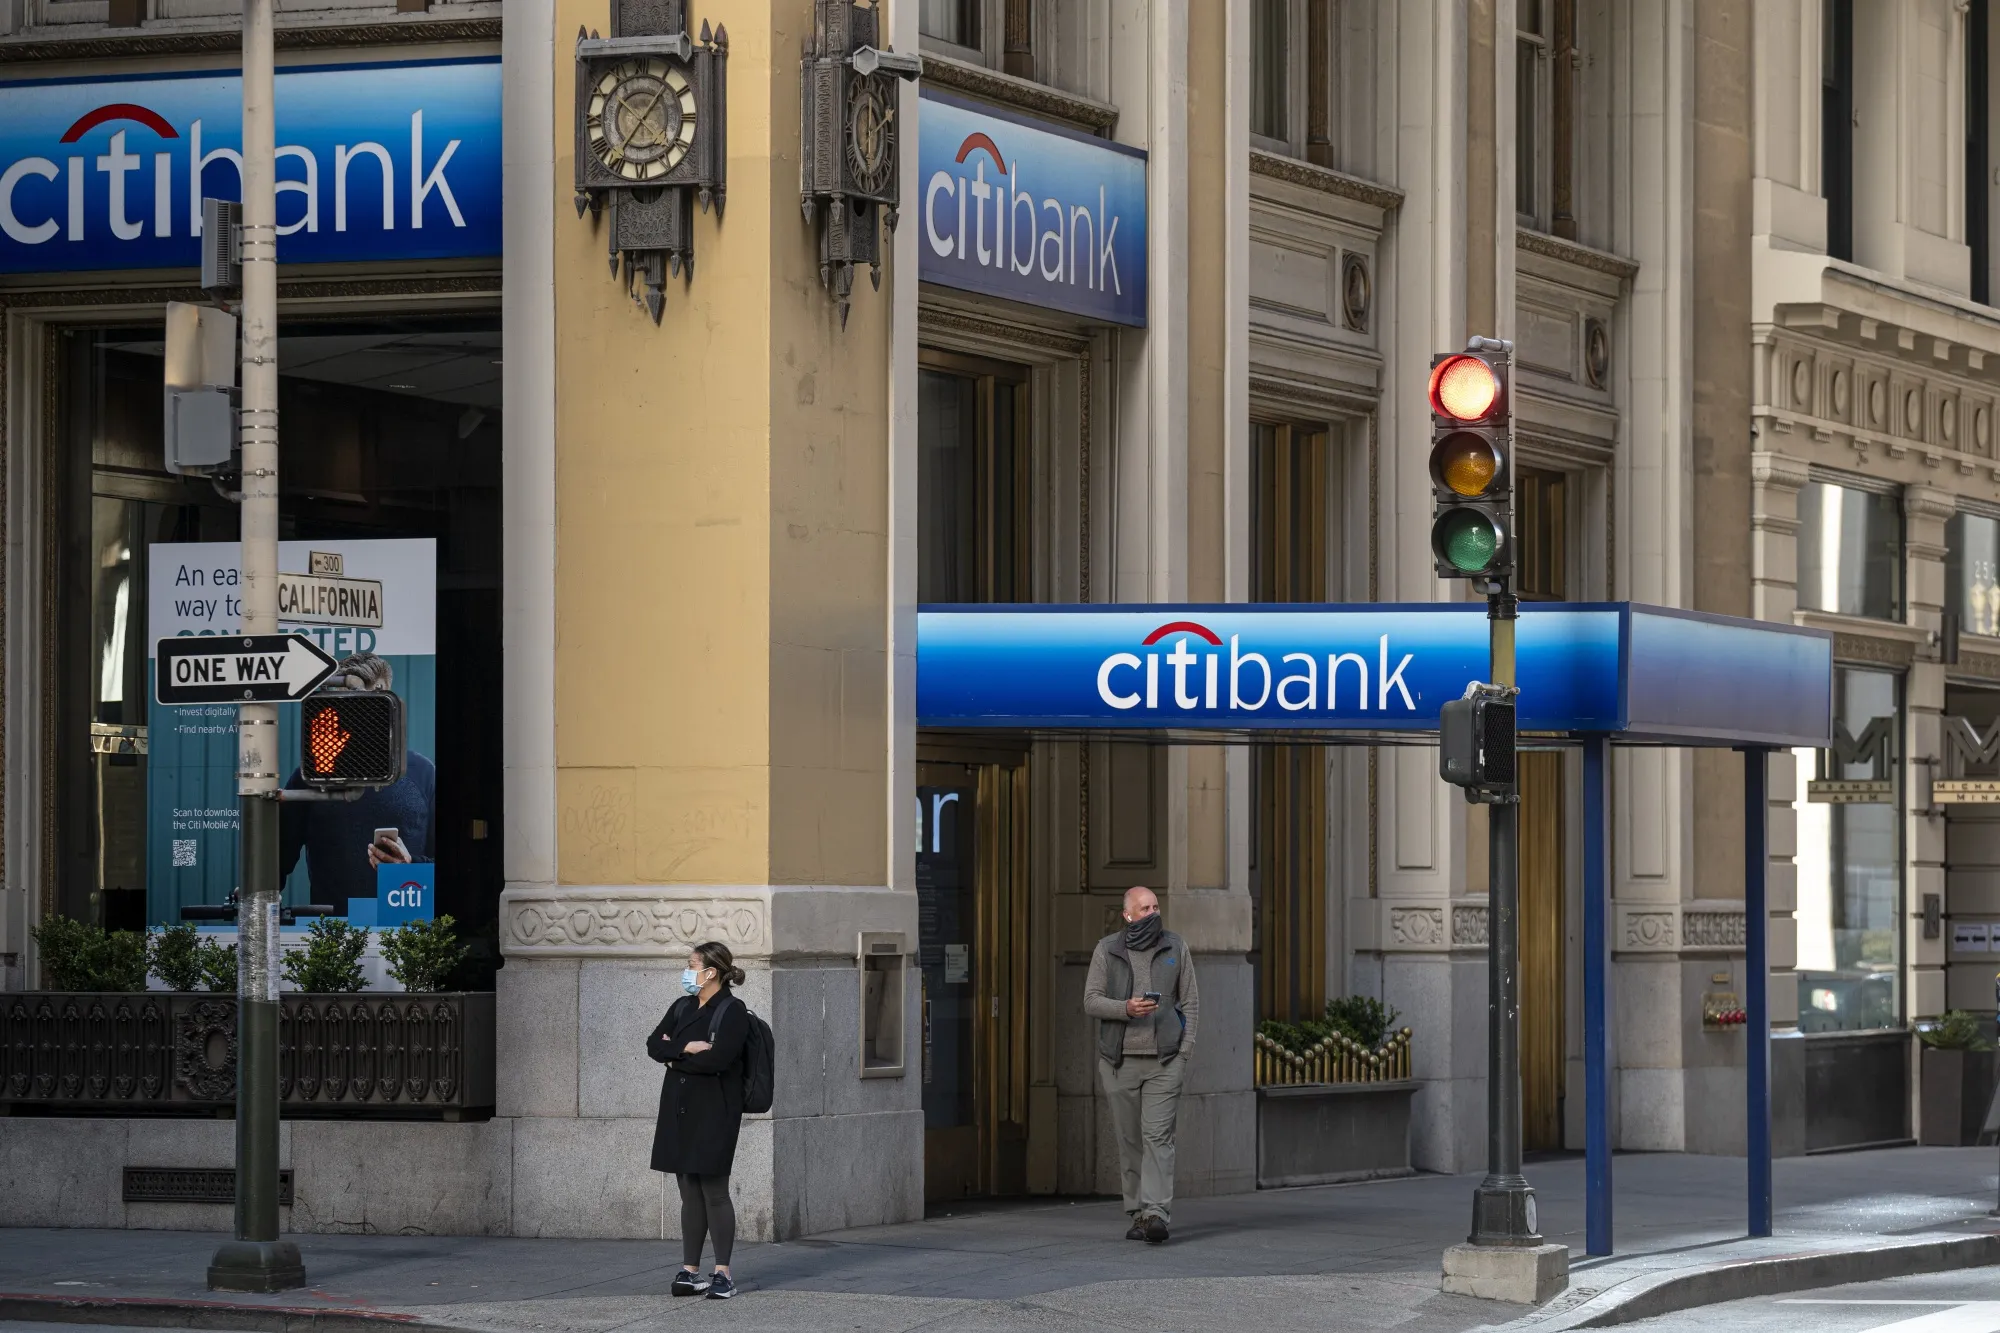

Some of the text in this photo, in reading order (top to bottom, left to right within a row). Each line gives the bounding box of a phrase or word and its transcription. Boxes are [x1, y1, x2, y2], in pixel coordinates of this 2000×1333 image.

[0, 107, 467, 245] citibank
[925, 155, 1122, 297] citibank
[323, 555, 340, 572] 300
[175, 564, 242, 587] An ea
[175, 599, 218, 622] way
[278, 582, 379, 619] CALIFORNIA
[175, 655, 286, 683] ONE WAY
[1097, 632, 1417, 711] citibank
[179, 706, 237, 718] Invest digitally
[179, 724, 197, 734] Find
[197, 724, 227, 735] nearby
[173, 808, 193, 817] Scan
[194, 808, 203, 817] to
[173, 820, 187, 830] the
[187, 820, 201, 830] Citi
[387, 883, 422, 908] citi
